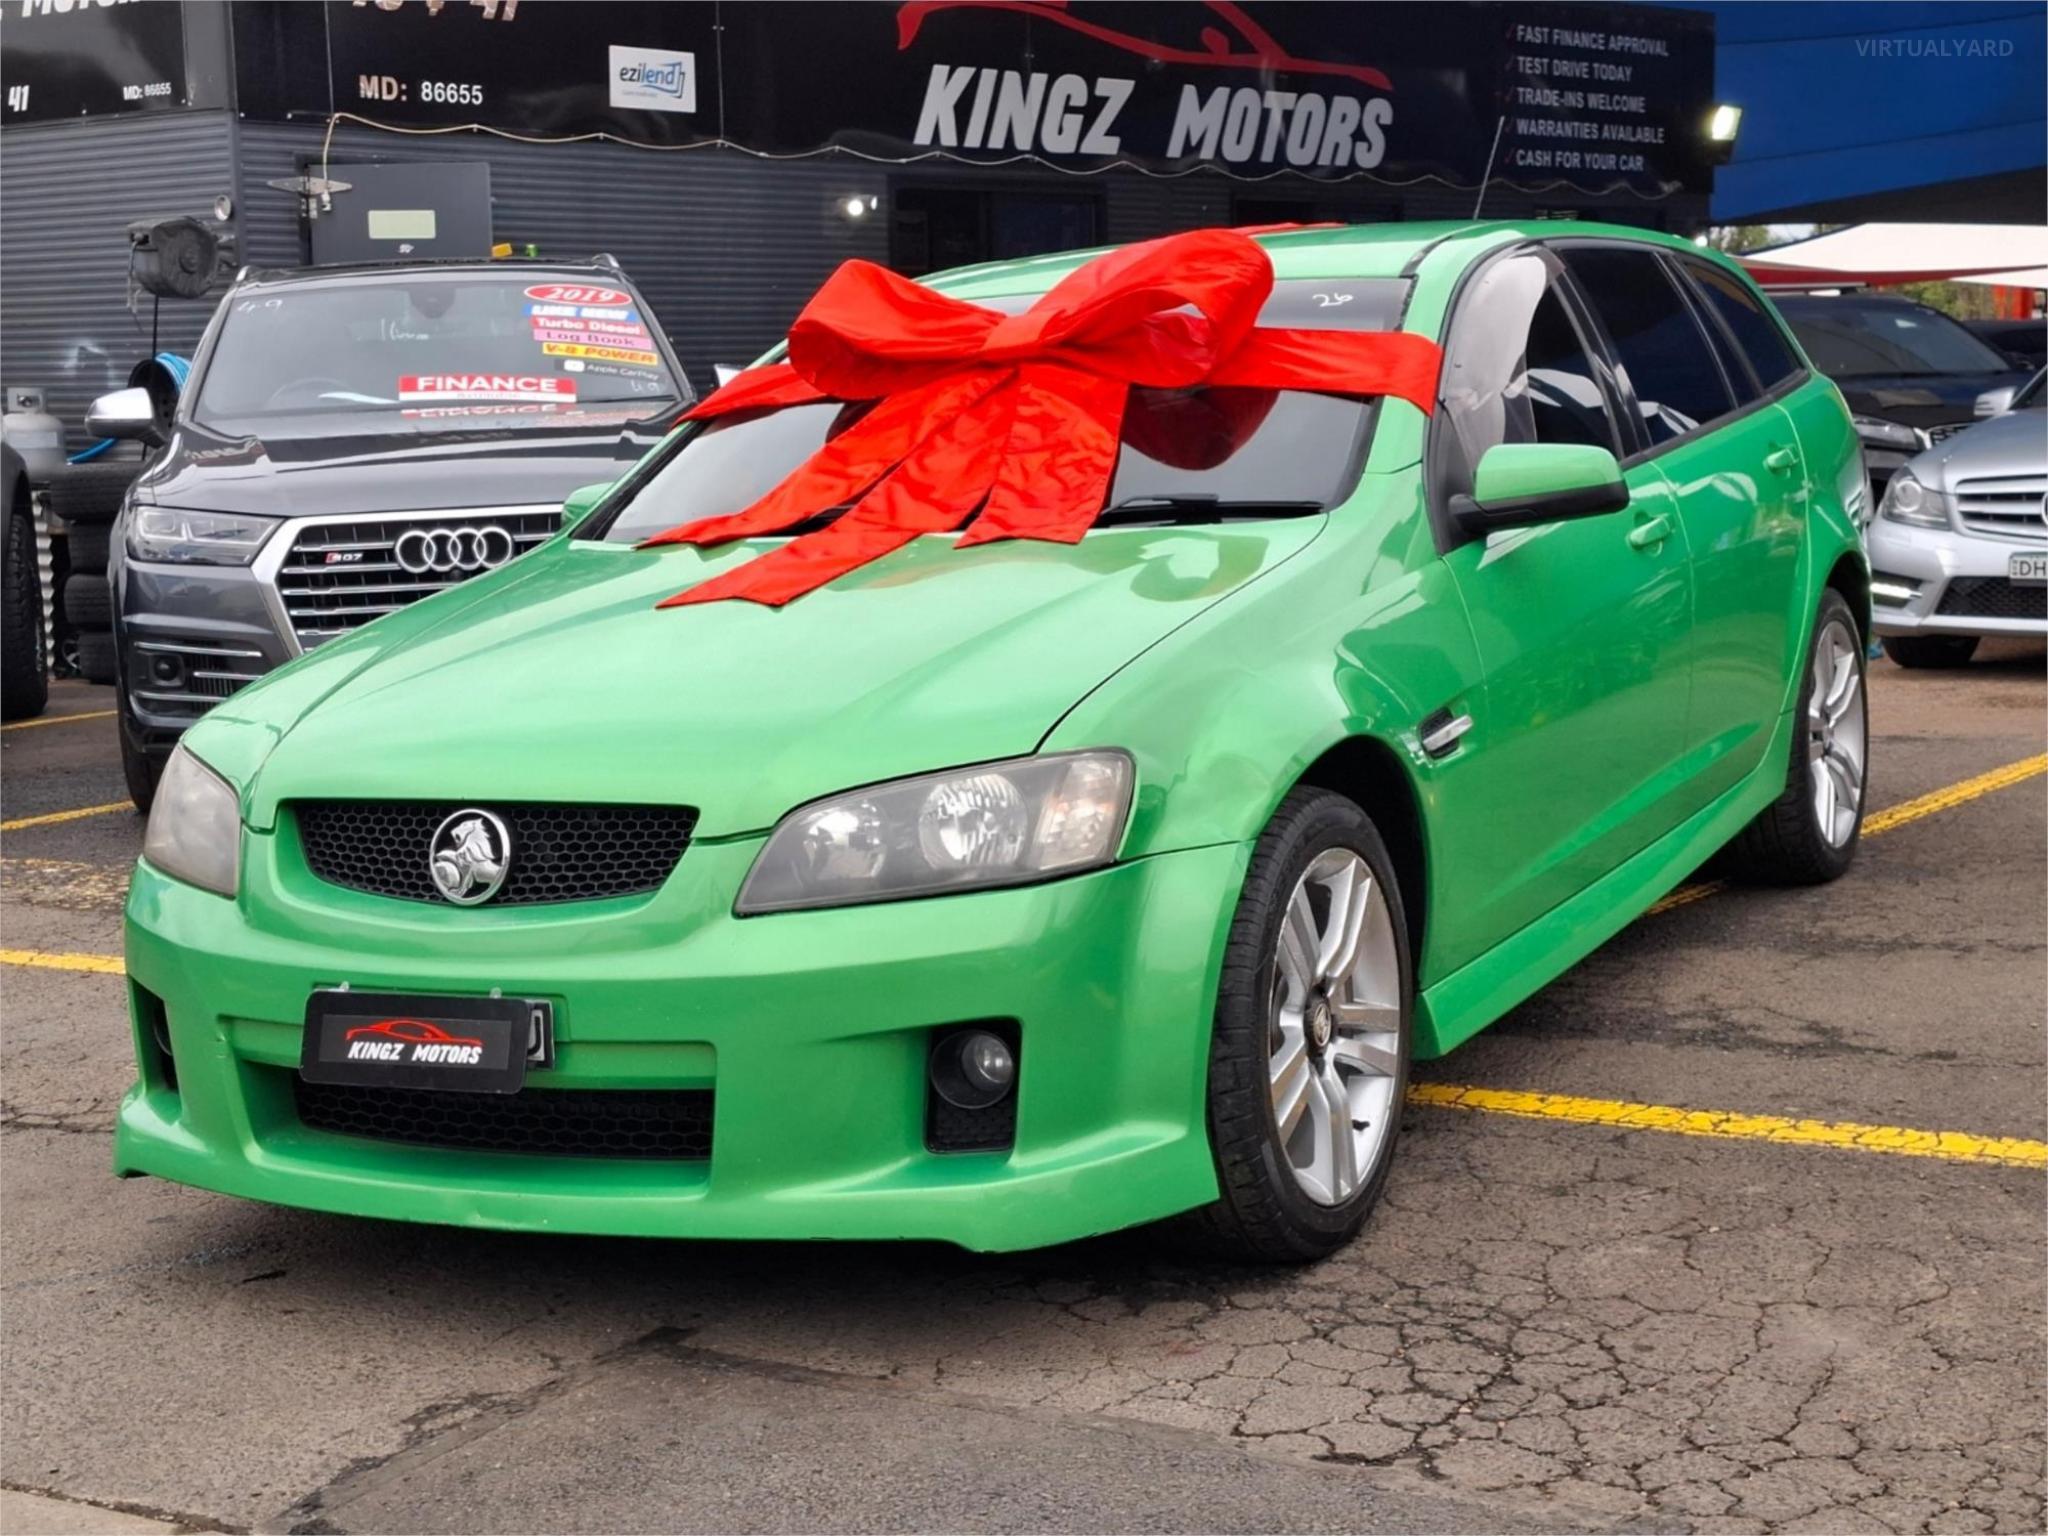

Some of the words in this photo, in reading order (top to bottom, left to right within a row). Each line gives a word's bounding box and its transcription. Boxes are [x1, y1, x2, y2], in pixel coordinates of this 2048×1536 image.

[1517, 25, 1549, 43] FAST
[1553, 29, 1605, 50] FINANCE
[1608, 35, 1669, 56] APPROVAL
[620, 63, 675, 84] ezilend
[1517, 56, 1548, 74] TEST
[1553, 59, 1589, 78] DRIVE
[1593, 63, 1632, 82] TODAY
[123, 86, 143, 100] MD:
[359, 75, 407, 101] MD:
[421, 81, 483, 105] 86655
[1517, 87, 1584, 108] TRADE-INS
[1587, 93, 1646, 113] WELCOME
[913, 64, 1135, 155] KINGZ
[1166, 84, 1394, 168] MOTORS
[1517, 119, 1598, 140] WARRANTIES
[1602, 124, 1664, 144] AVAILABLE
[1517, 150, 1552, 167] CASH
[1555, 152, 1581, 169] FOR
[1584, 153, 1616, 170] YOUR
[1620, 155, 1644, 171] CAR
[544, 287, 615, 301] 2019
[537, 317, 584, 331] Turbo
[588, 321, 640, 335] Diesel
[547, 332, 580, 343] Log
[587, 334, 635, 347] Book
[585, 347, 656, 363] POWER
[417, 376, 558, 393] FINANCE
[348, 1041, 404, 1061] KINGZ
[412, 1044, 482, 1065] MOTORS
